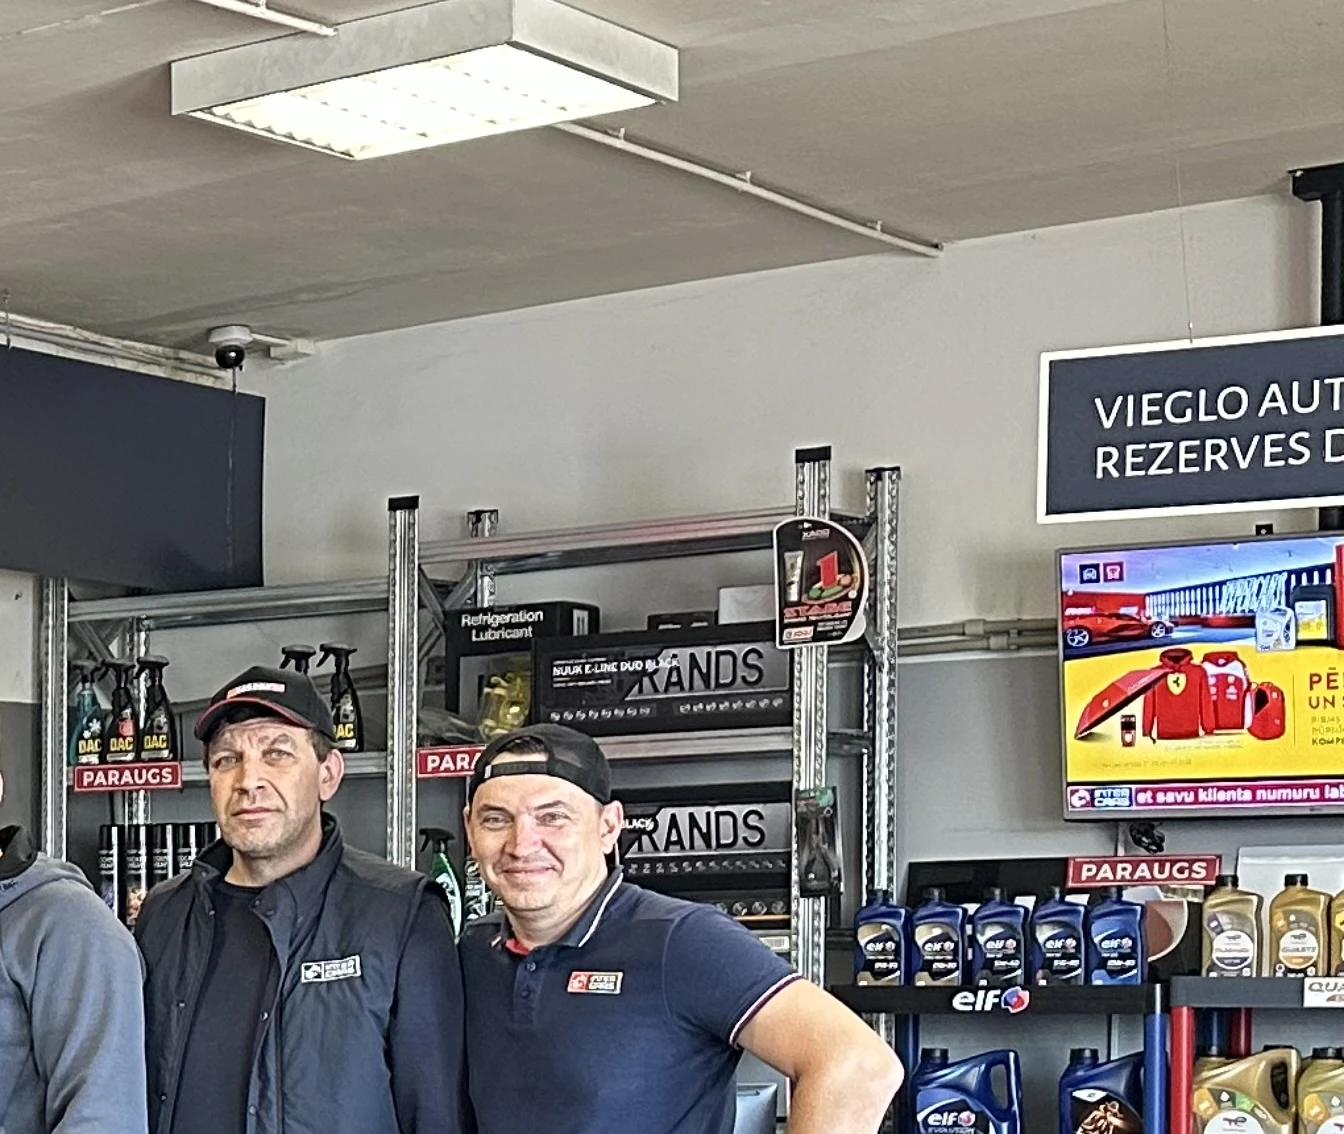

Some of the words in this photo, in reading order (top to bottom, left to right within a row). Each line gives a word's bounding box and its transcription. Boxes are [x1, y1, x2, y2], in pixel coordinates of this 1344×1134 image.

[1095, 386, 1250, 429] VIEGLO
[1096, 431, 1311, 480] REZERVES
[461, 609, 543, 627] Refrigeration
[472, 627, 533, 642] Lubricant
[1309, 667, 1344, 691] PĒ
[1309, 695, 1335, 710] UN
[78, 739, 102, 753] DAC
[110, 737, 134, 751] DAC
[144, 734, 168, 750] DAC
[427, 753, 480, 773] PAR
[82, 767, 173, 786] PARAUGS
[1255, 786, 1320, 801] numuru
[1081, 860, 1208, 882] PARAUGS
[952, 989, 1000, 1012] elf
[928, 1111, 959, 1126] elf
